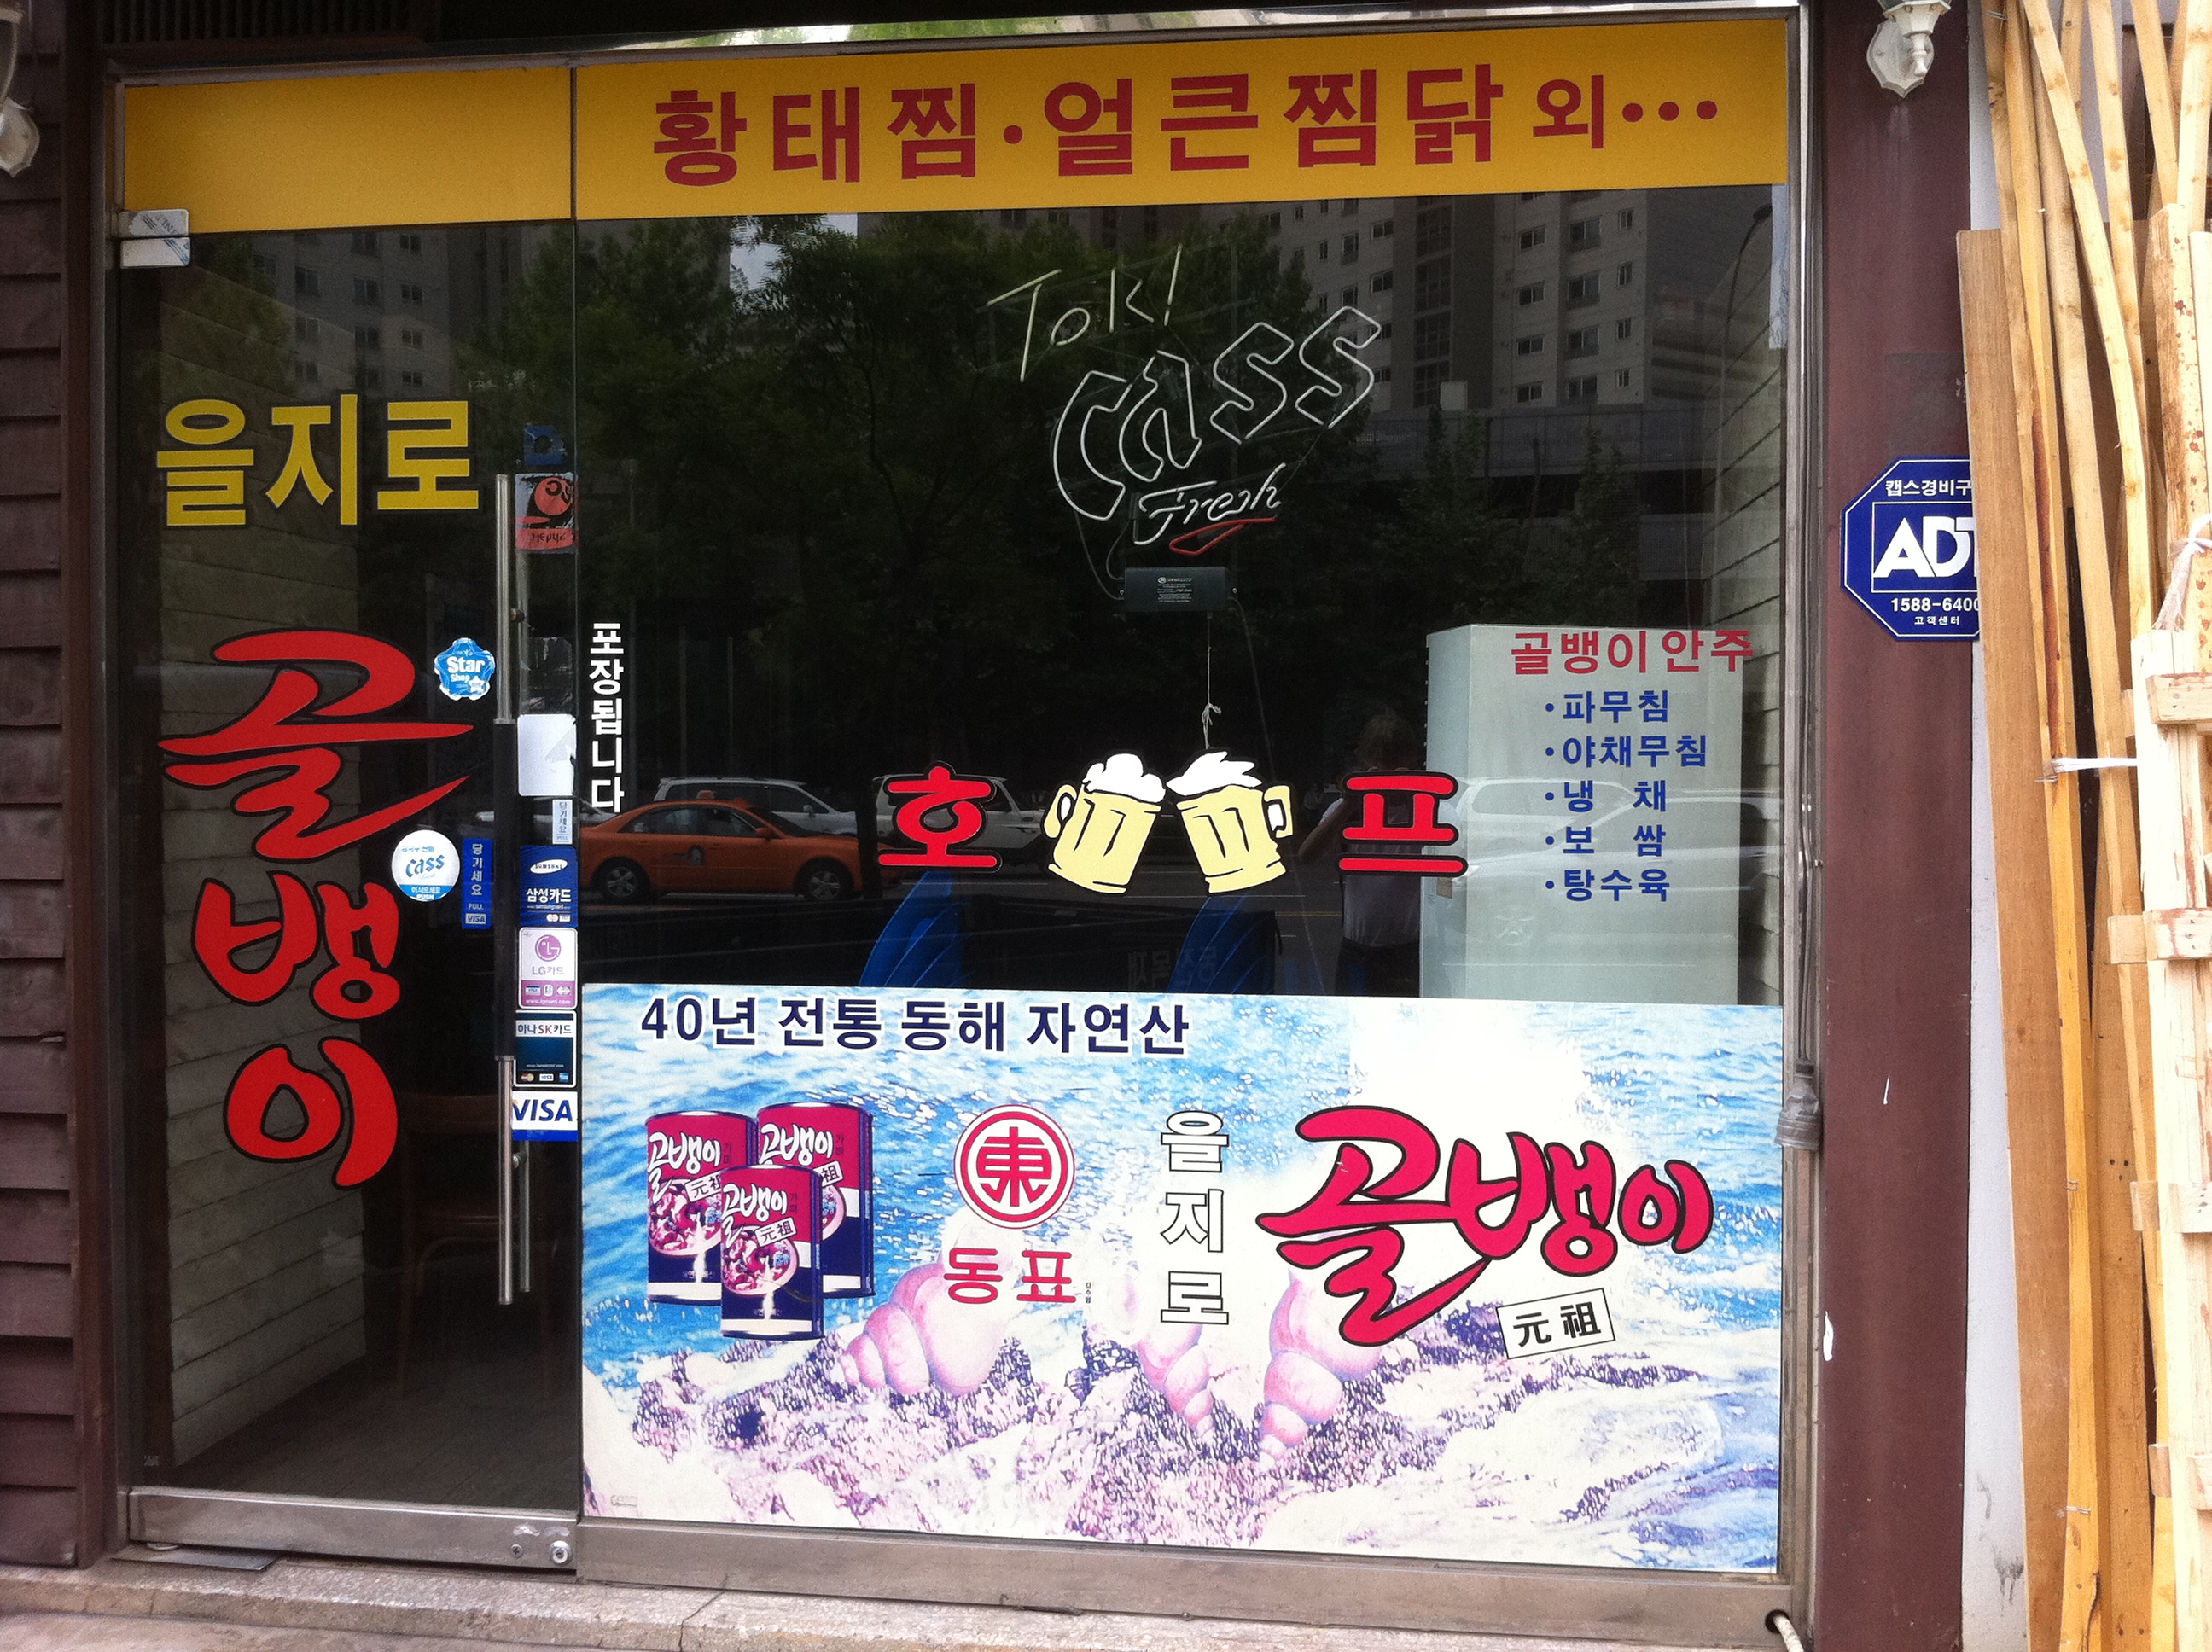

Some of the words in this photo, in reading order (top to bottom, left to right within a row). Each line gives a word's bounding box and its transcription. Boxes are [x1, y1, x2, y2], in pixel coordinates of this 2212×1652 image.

[156, 394, 480, 526] 을지로
[1914, 615, 1959, 625] 고객센터
[446, 656, 486, 672] Star
[450, 672, 470, 683] Shop
[590, 622, 625, 813] 포장됩니다
[1563, 690, 1669, 724] 파무침
[1562, 735, 1707, 768] 야채무침
[877, 765, 998, 869] 호
[1338, 774, 1465, 873] 프
[470, 843, 484, 896] 당기세요
[1563, 869, 1670, 901] 탕수육
[158, 630, 474, 1187] 골뱅이
[526, 888, 572, 904] 삼성카드
[467, 915, 486, 923] VISA
[532, 966, 565, 976] LG카드
[517, 1024, 572, 1035] 하나SK카드
[641, 997, 756, 1047] 40년
[777, 997, 882, 1050] 전통
[899, 1000, 1006, 1053] 동해
[1027, 1001, 1190, 1056] 자연산
[513, 1099, 573, 1122] VISA
[647, 1131, 721, 1204] 골뱅이
[720, 1183, 789, 1249] 골뱅이
[760, 1220, 794, 1243] 元祖
[1160, 1109, 1230, 1325] 을지로
[1255, 1105, 1714, 1347] 골뱅이
[943, 1248, 1077, 1305] 동표
[1513, 1301, 1601, 1347] 元祖
